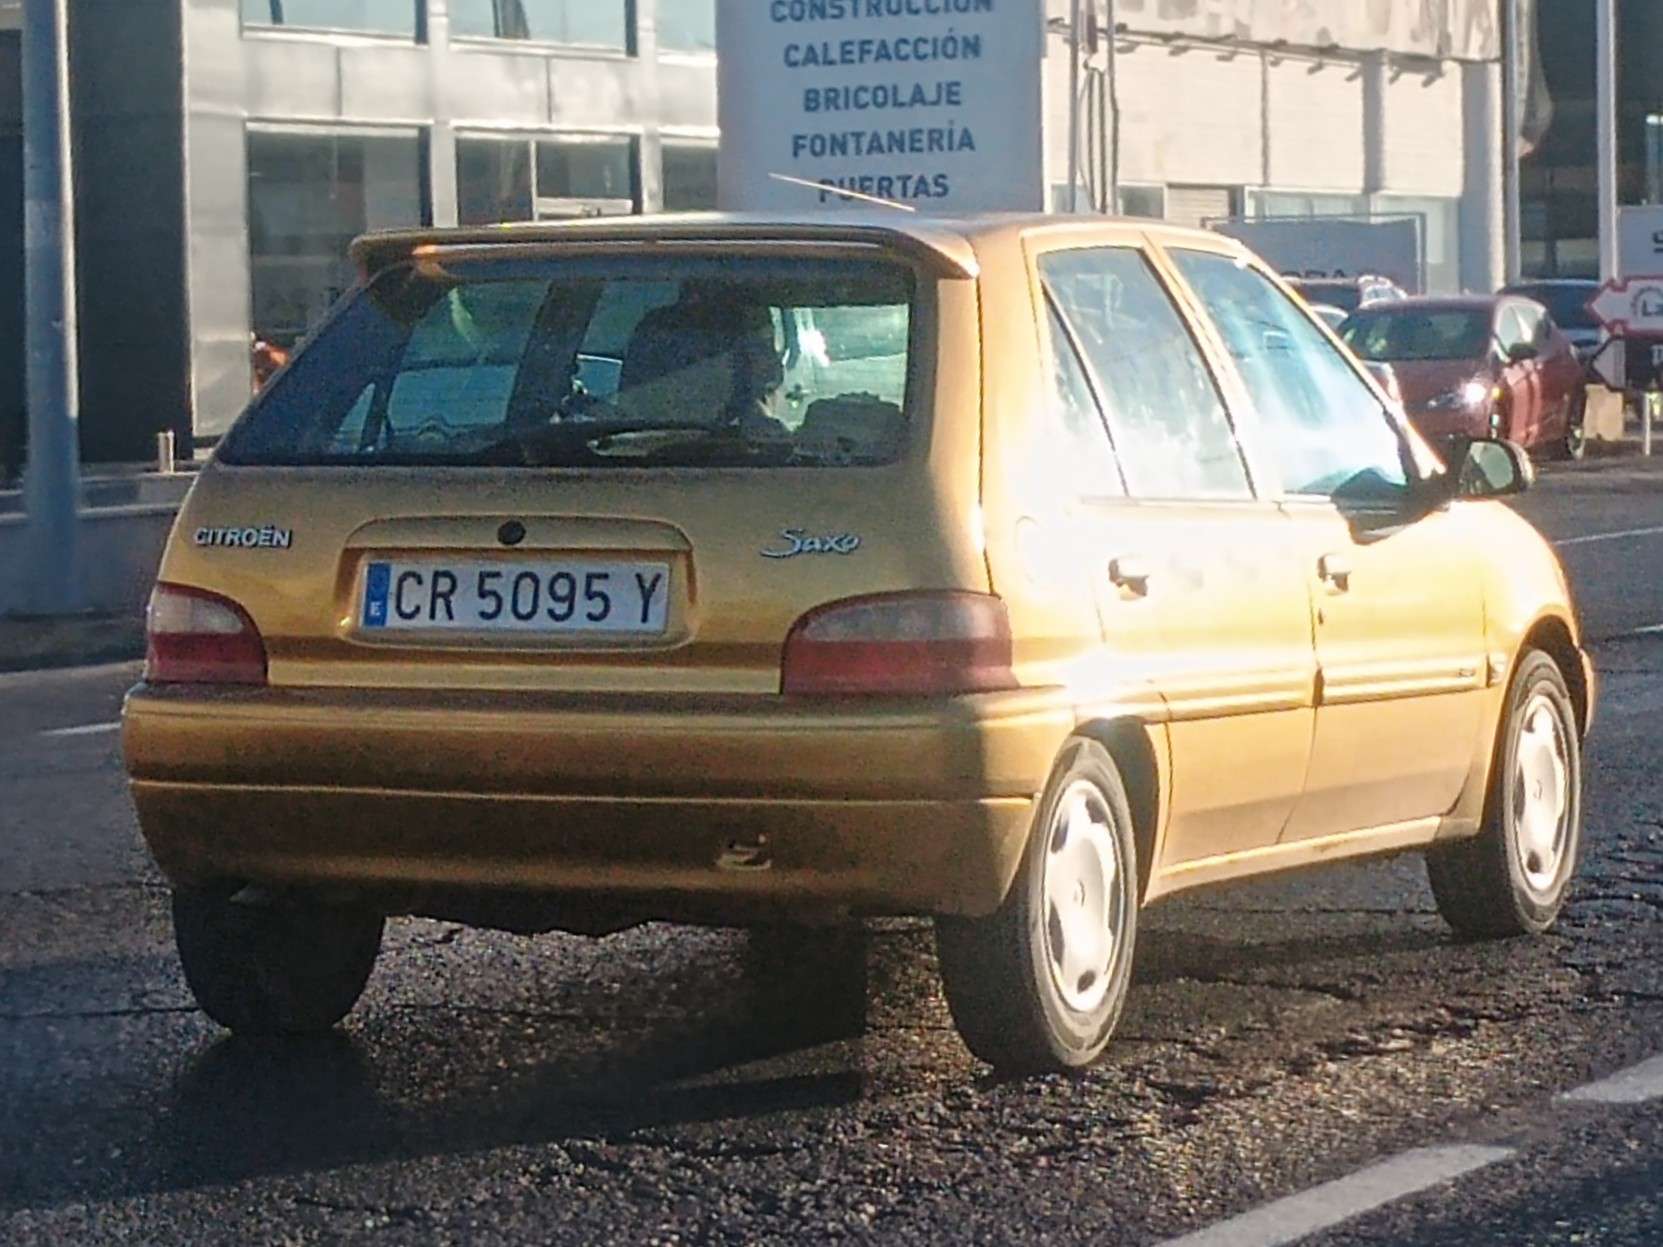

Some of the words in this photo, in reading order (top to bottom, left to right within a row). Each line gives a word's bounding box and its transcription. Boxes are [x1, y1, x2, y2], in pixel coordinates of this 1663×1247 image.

[783, 27, 982, 68] CALEFACCIÓN
[803, 81, 962, 112] BRICOLAJE
[792, 120, 976, 158] FONTANERÍA
[819, 173, 950, 203] PUERTAS
[193, 525, 292, 549] CITROËN
[760, 528, 861, 558] Saxo
[395, 570, 458, 621] CR
[477, 570, 612, 624] 5095
[636, 573, 662, 625] Y
